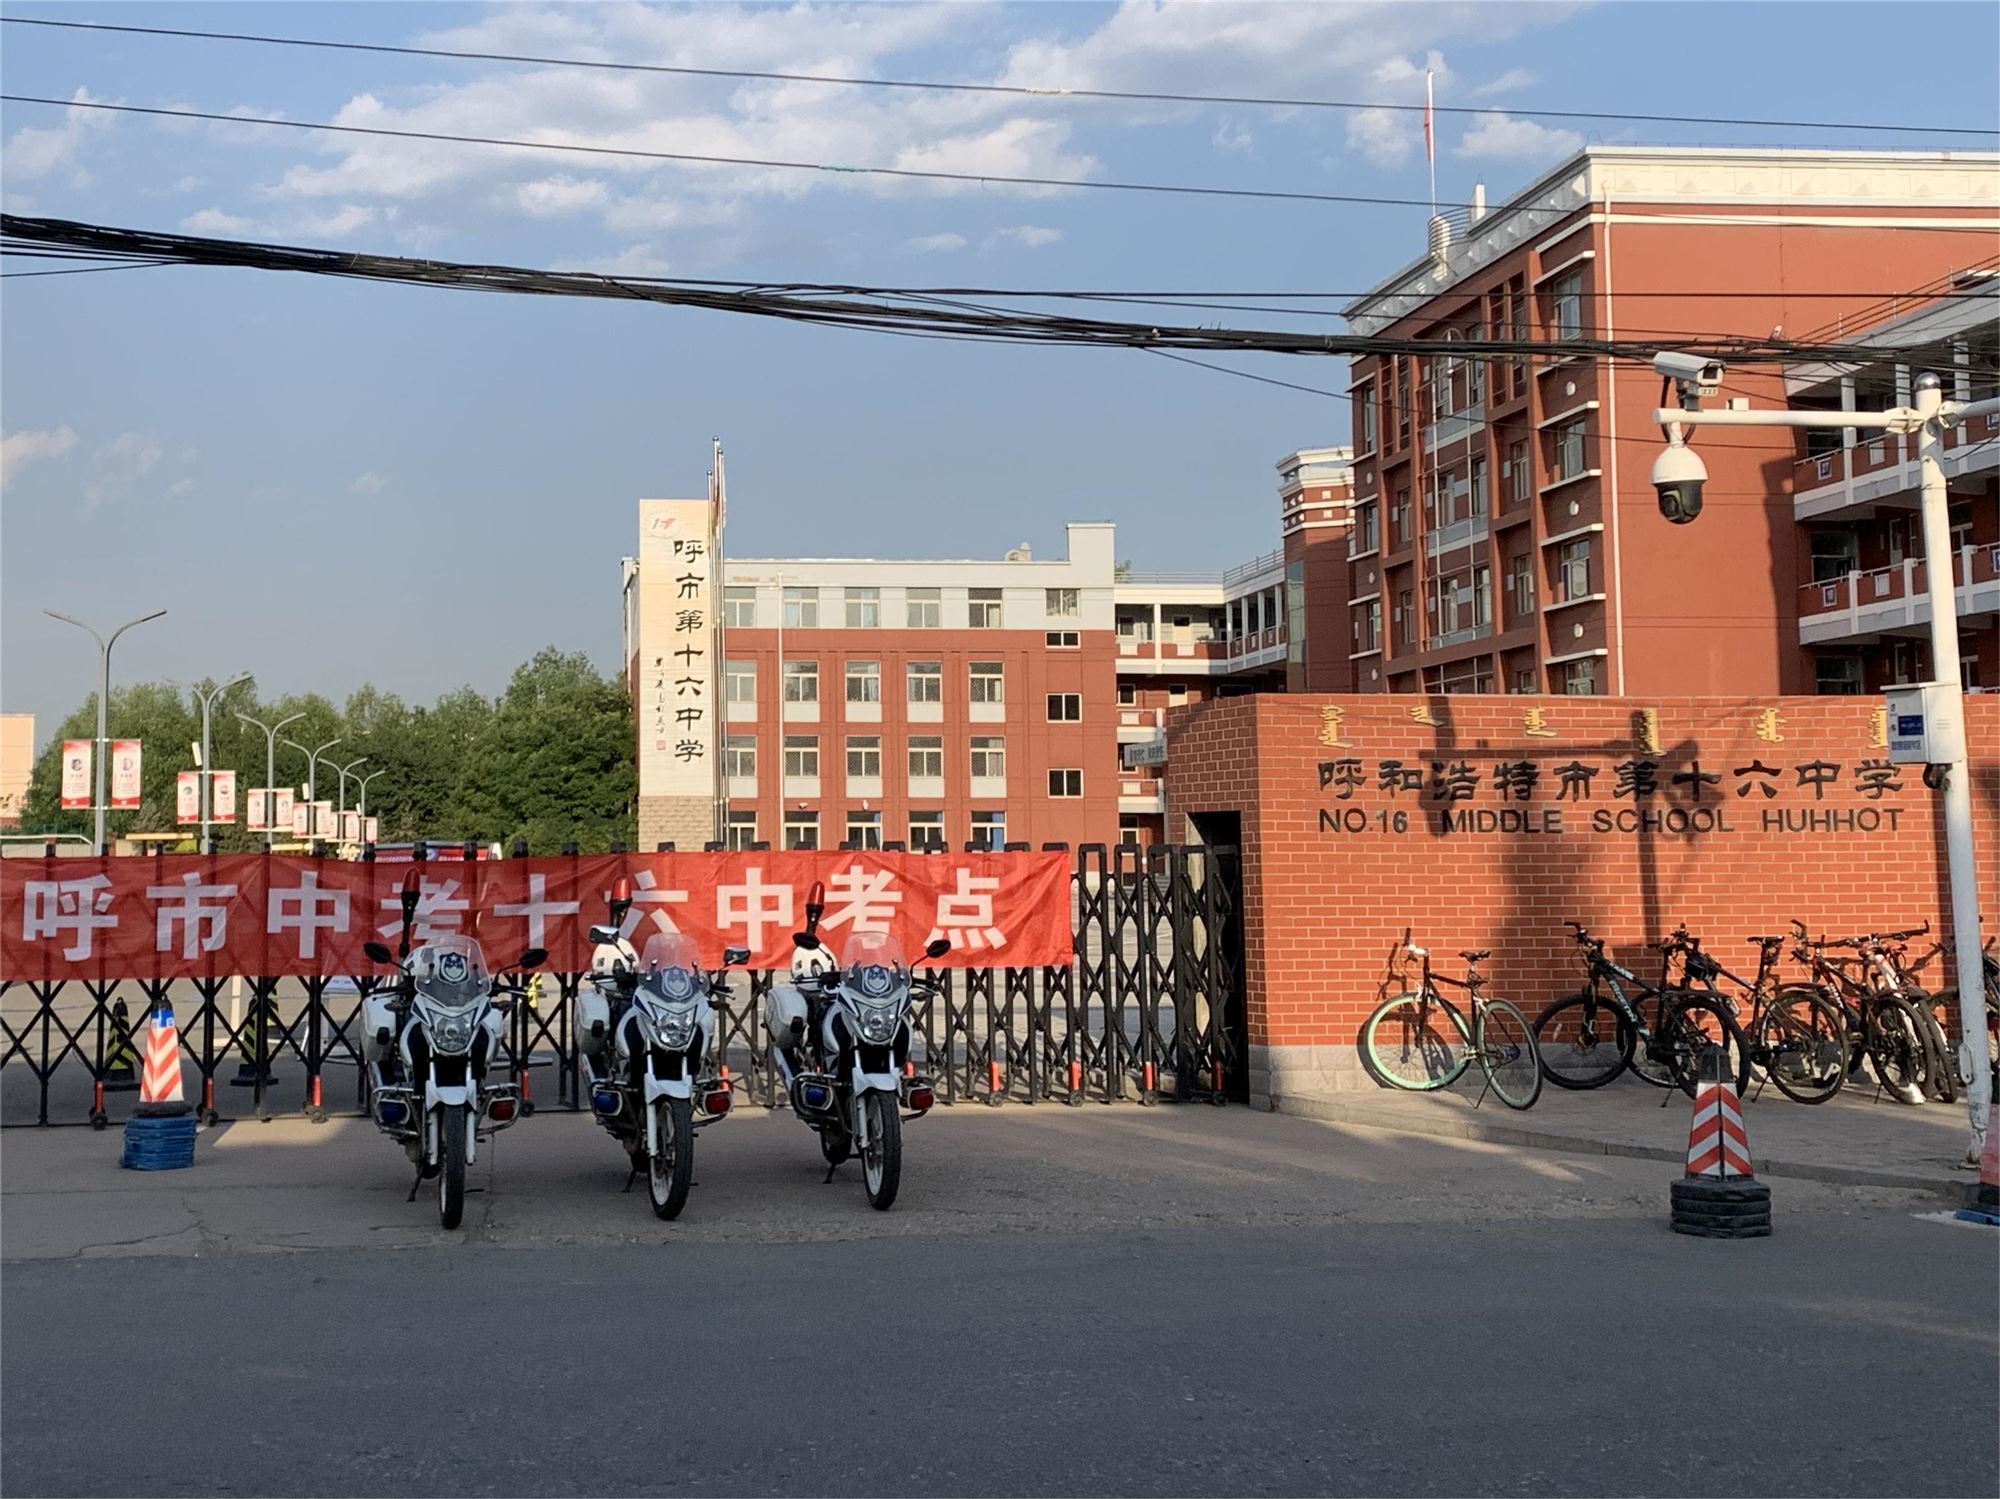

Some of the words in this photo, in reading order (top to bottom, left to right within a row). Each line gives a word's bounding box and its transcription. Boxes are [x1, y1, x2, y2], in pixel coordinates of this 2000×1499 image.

[673, 539, 704, 763] 呼市第十六中学
[1318, 758, 1903, 802] 呼和浩特市第十六中学
[1318, 807, 1408, 834] NO.16
[1441, 808, 1563, 834] MIDDLE
[1592, 807, 1734, 834] SCHOOL
[1762, 806, 1904, 833] HUHHOT
[23, 865, 1006, 961] 呼市中考十六中考点
